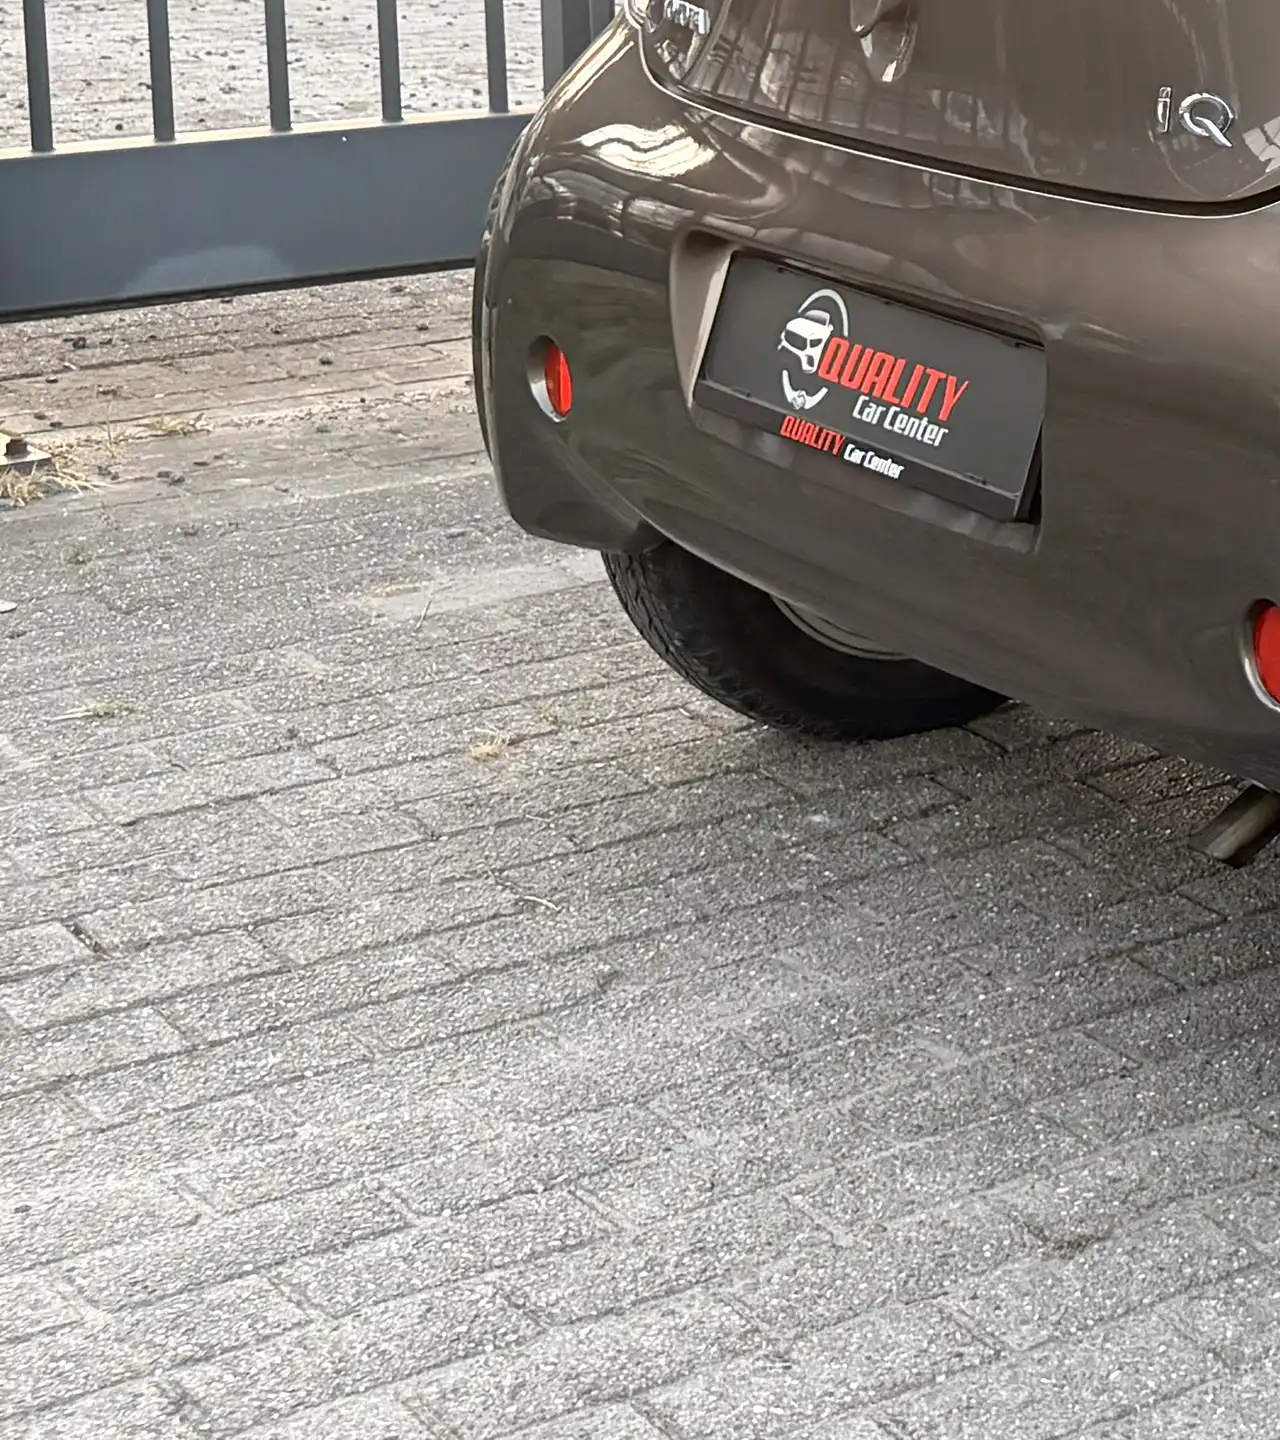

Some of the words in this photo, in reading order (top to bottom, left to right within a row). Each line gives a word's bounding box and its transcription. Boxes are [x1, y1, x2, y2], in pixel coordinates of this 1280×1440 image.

[818, 336, 969, 421] QUALITY
[780, 415, 846, 456] QUALITY
[843, 443, 867, 465] Car
[863, 450, 905, 480] Center
[852, 394, 886, 425] Car
[883, 405, 949, 447] Center
